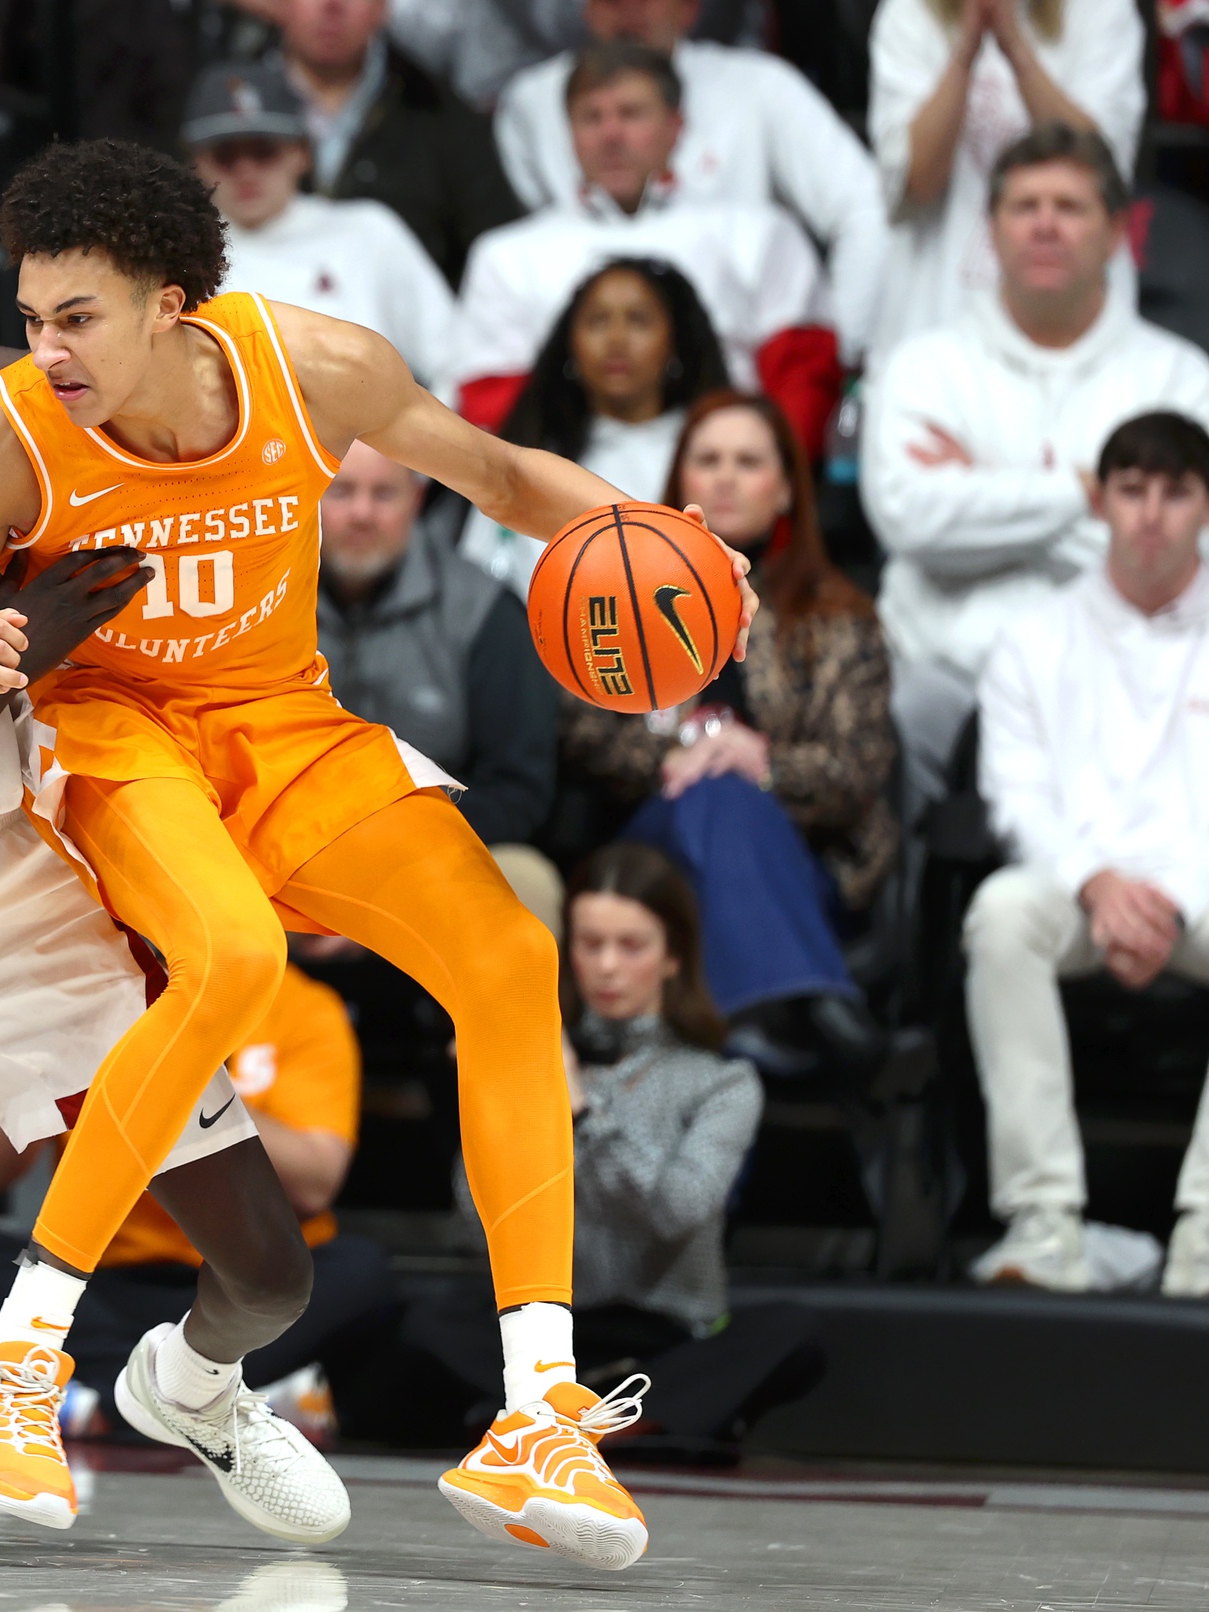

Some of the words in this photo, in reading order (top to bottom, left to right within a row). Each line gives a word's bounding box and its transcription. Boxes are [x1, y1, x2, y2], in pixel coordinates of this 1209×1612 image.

[263, 441, 284, 463] SEC
[68, 495, 300, 552] TENNESSEE
[93, 567, 292, 664] OLUNTEERS
[138, 549, 235, 621] 10
[589, 595, 635, 696] ELITE
